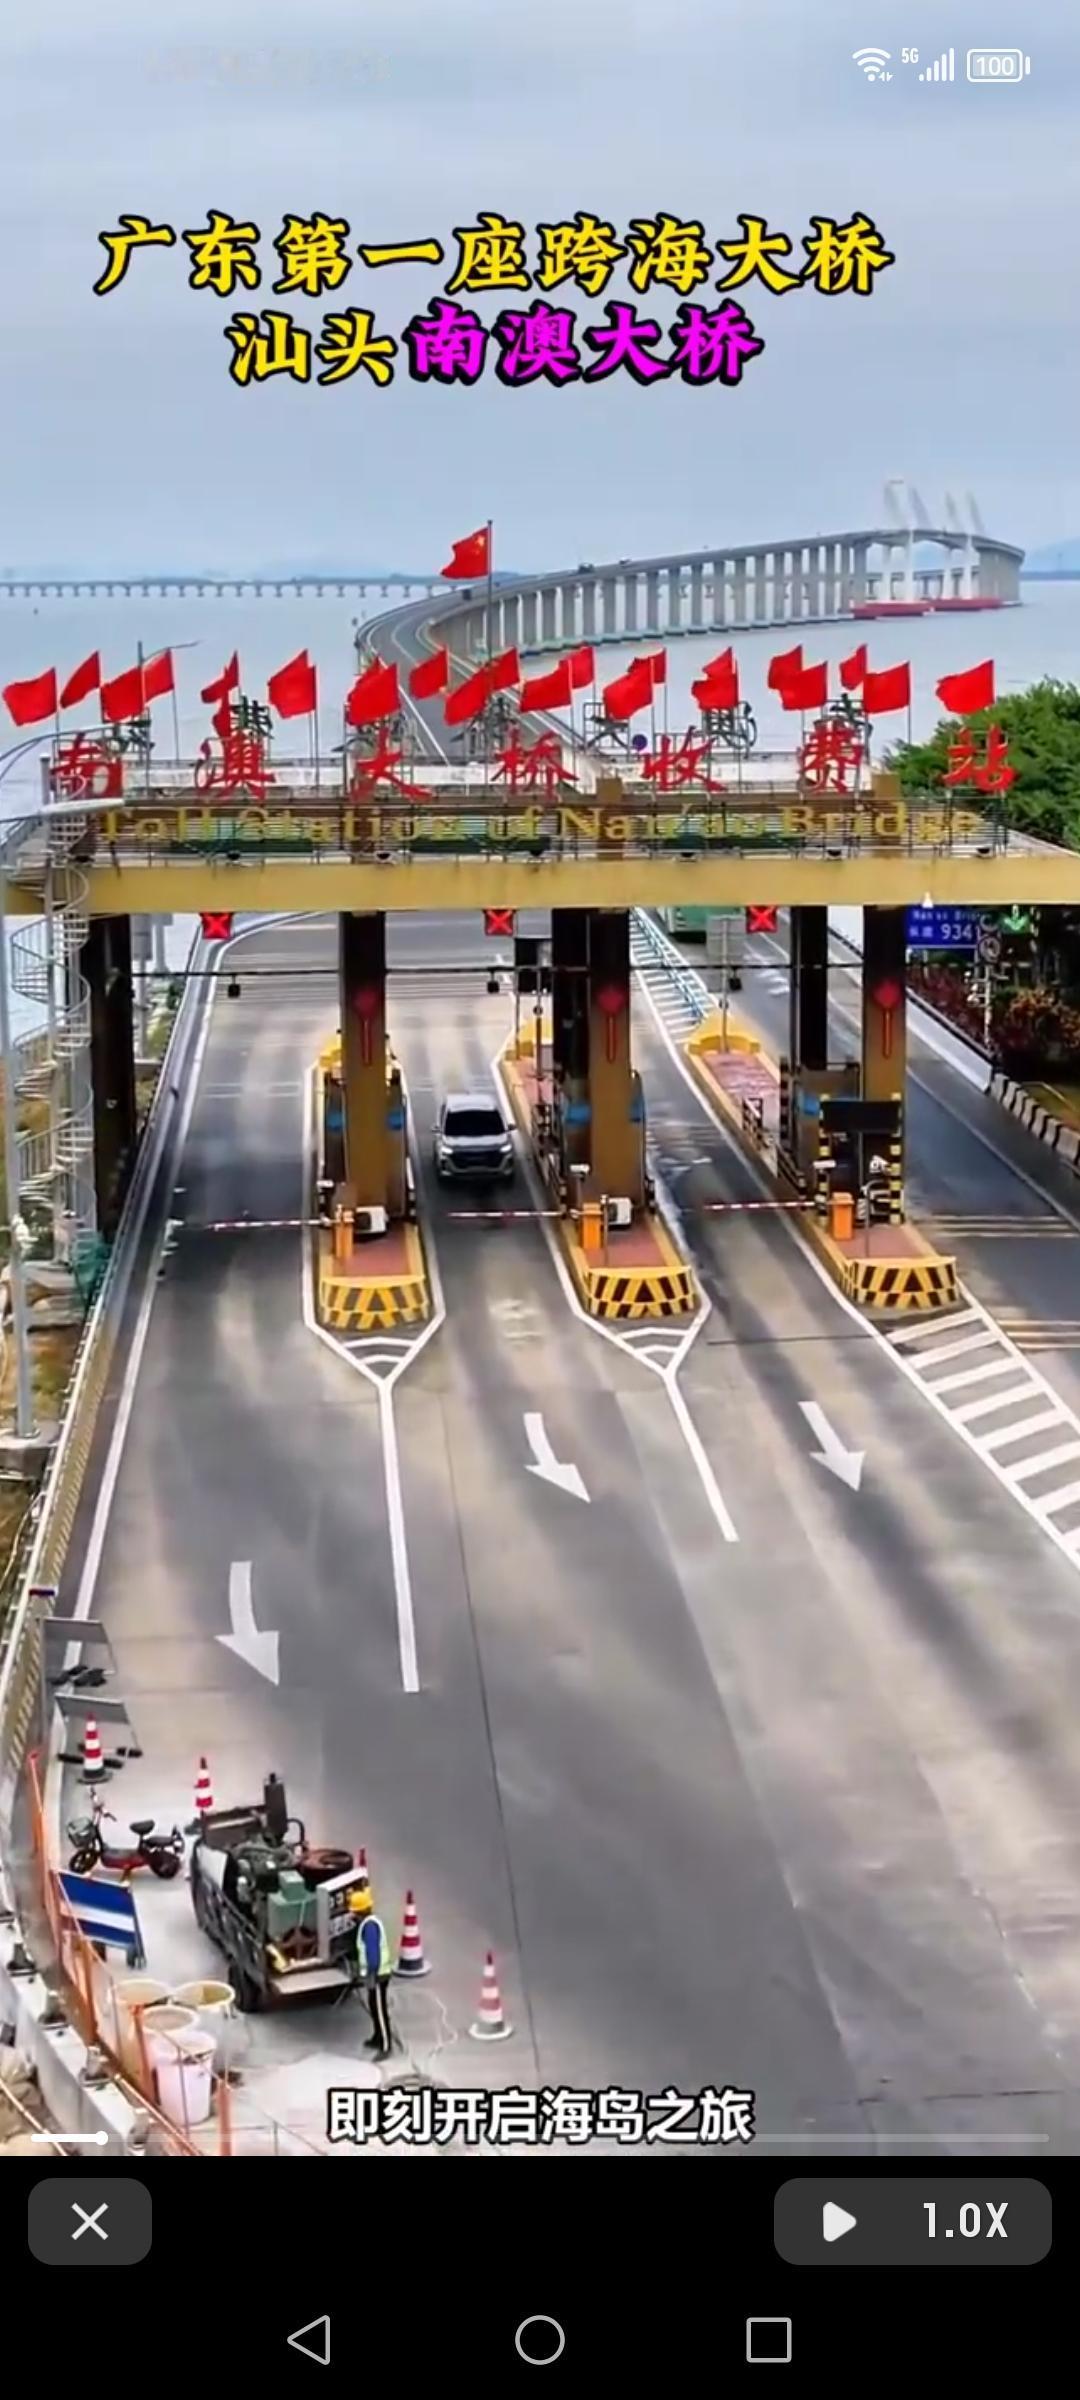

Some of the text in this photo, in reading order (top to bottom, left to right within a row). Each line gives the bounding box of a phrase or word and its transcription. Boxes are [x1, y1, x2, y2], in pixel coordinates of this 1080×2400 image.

[50, 722, 1017, 807] 南澳大桥收费站
[99, 807, 212, 841] Toll
[238, 806, 468, 842] Station
[486, 805, 543, 841] of
[780, 801, 982, 844] Bridge
